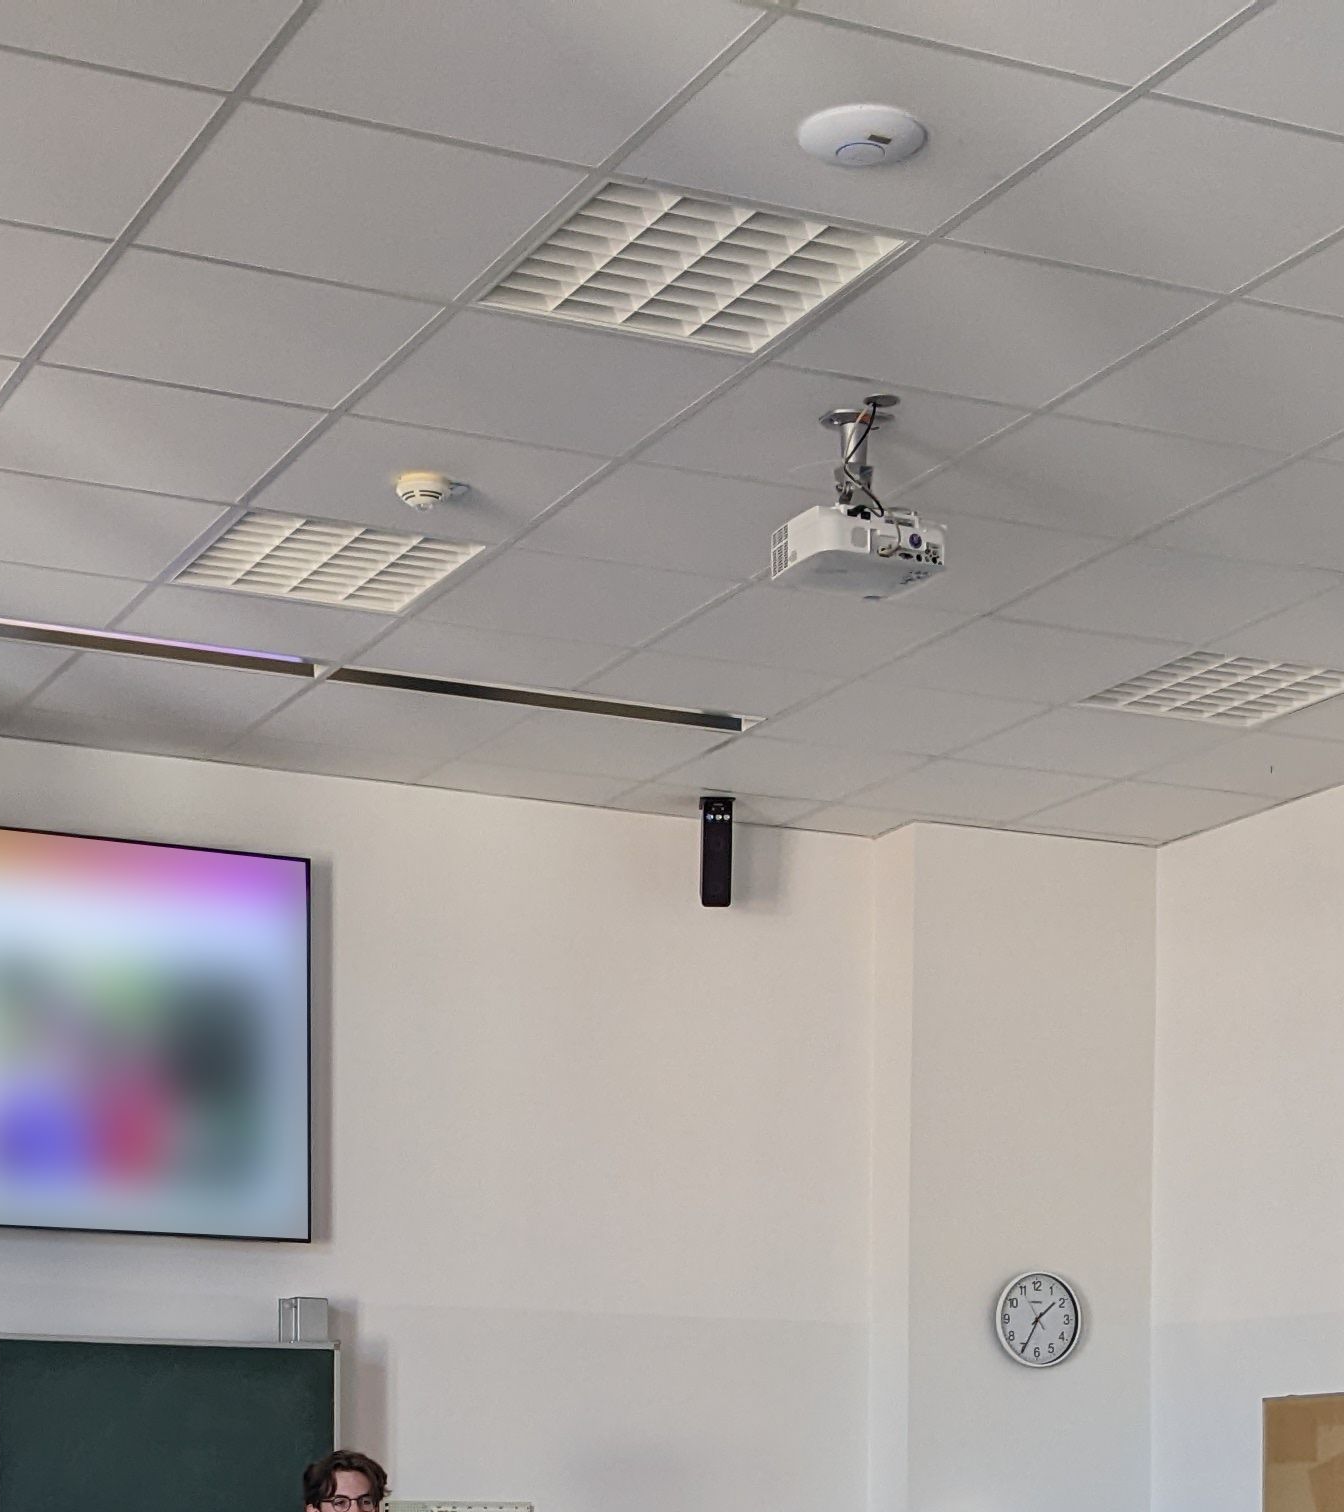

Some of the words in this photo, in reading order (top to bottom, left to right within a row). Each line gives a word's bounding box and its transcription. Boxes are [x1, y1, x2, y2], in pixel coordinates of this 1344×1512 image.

[1019, 1285, 1027, 1296] 11
[1032, 1280, 1042, 1291] 12
[1049, 1286, 1053, 1295] 1
[1008, 1298, 1018, 1308] 10
[1058, 1298, 1065, 1308] 2
[1003, 1313, 1010, 1324] 9
[1063, 1314, 1070, 1325] 3
[1008, 1330, 1015, 1341] 8
[1058, 1331, 1064, 1341] 4
[1033, 1347, 1040, 1357] 6
[1048, 1343, 1054, 1353] 5
